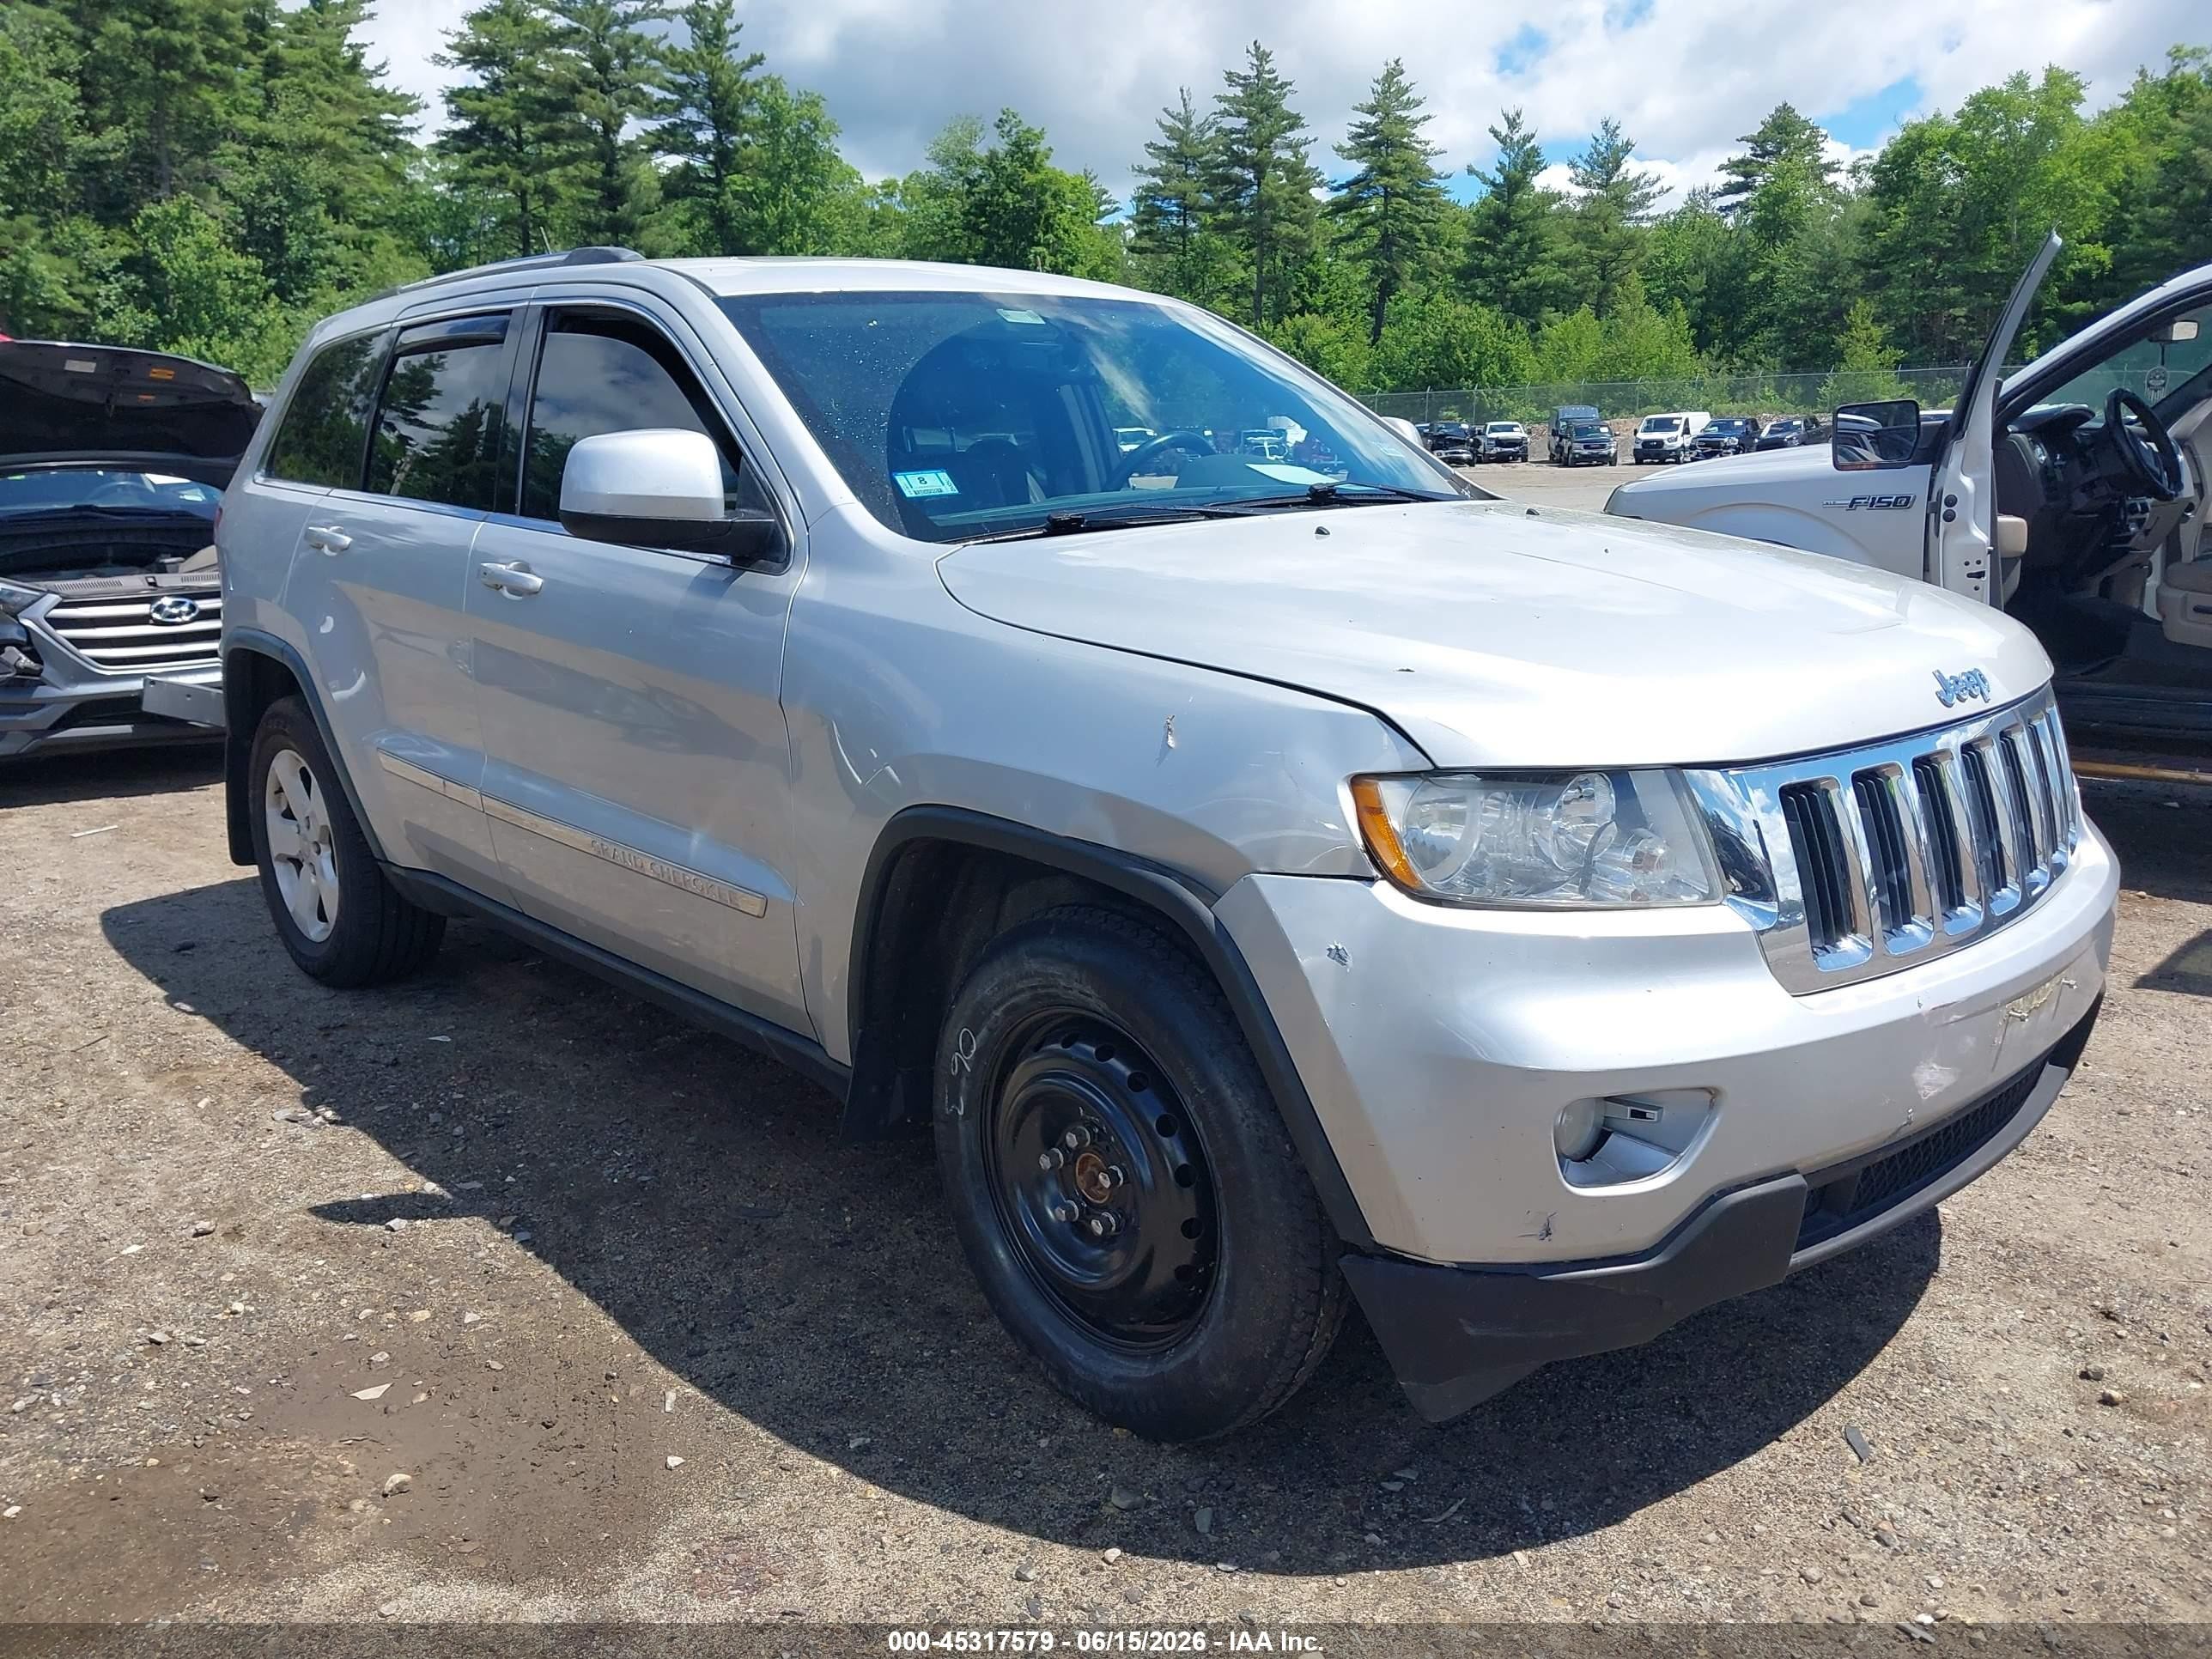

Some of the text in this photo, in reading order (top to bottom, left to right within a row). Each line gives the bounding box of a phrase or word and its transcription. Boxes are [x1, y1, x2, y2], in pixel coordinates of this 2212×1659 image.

[917, 477, 927, 485] 8
[1848, 495, 1913, 509] F-150
[1932, 667, 1990, 708] Jeep
[591, 839, 742, 907] GRAND CHEROKEE
